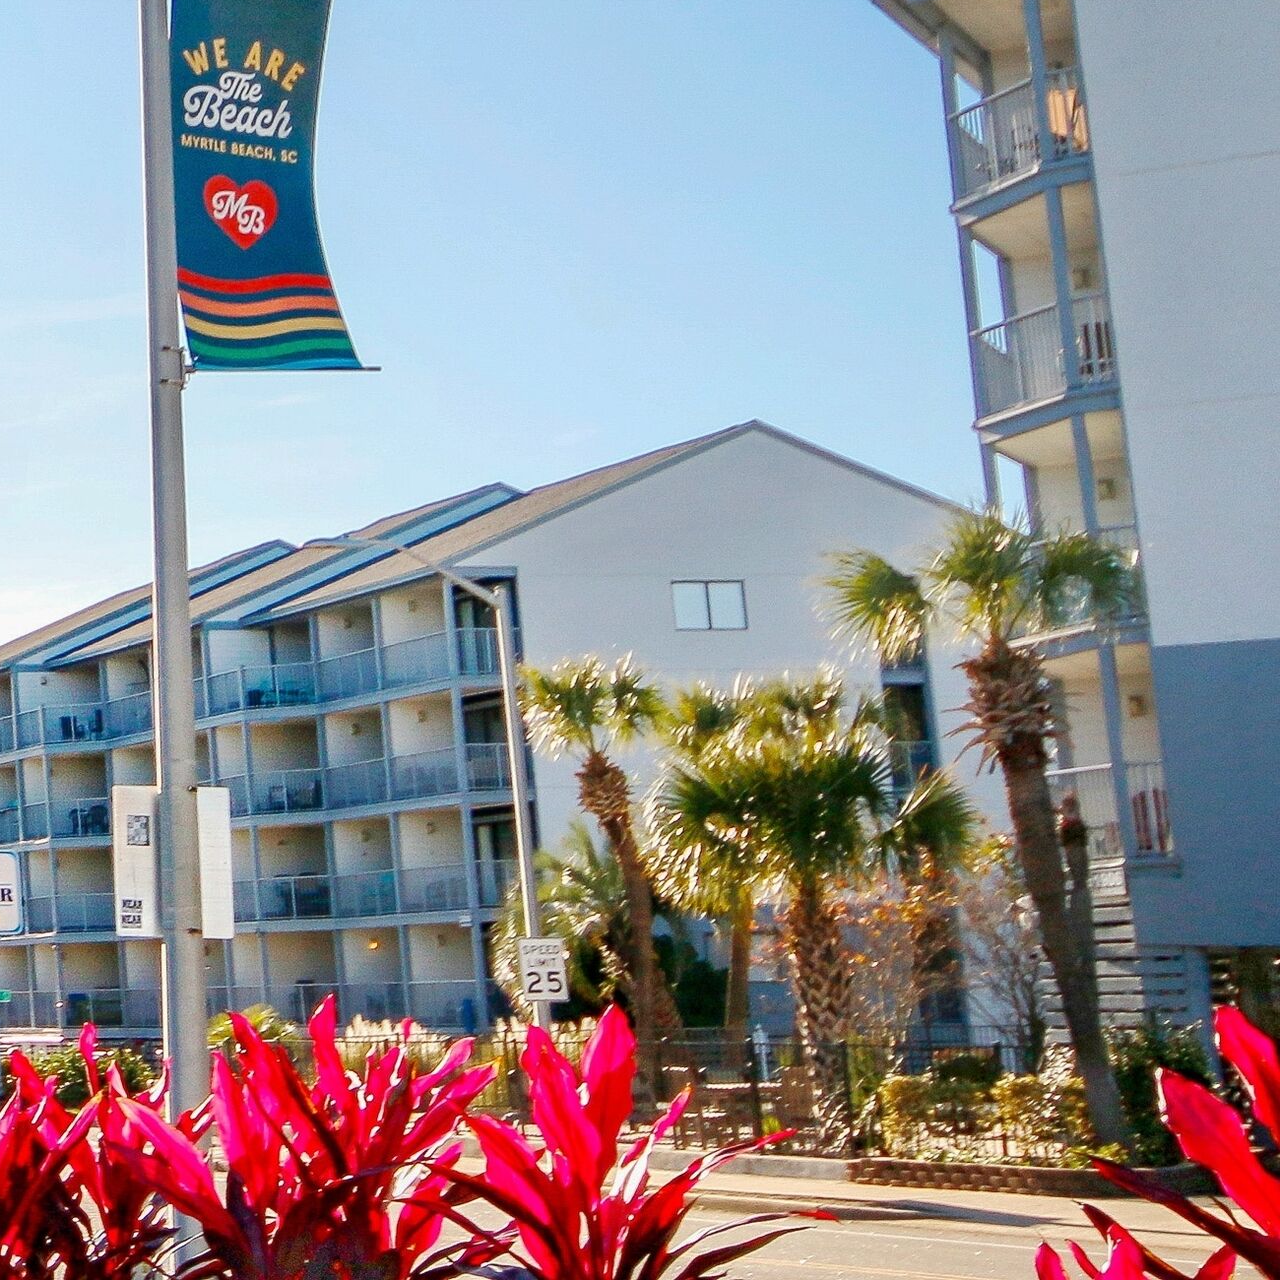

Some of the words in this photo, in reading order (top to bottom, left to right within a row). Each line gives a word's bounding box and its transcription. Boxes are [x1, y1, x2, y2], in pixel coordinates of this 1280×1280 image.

[183, 37, 228, 75] WE
[244, 39, 306, 91] ARE
[219, 71, 262, 103] The
[183, 85, 292, 138] Beach
[181, 134, 226, 152] MYRTLE
[281, 149, 297, 163] SC
[523, 945, 559, 954] SPEED
[526, 971, 562, 993] 25
